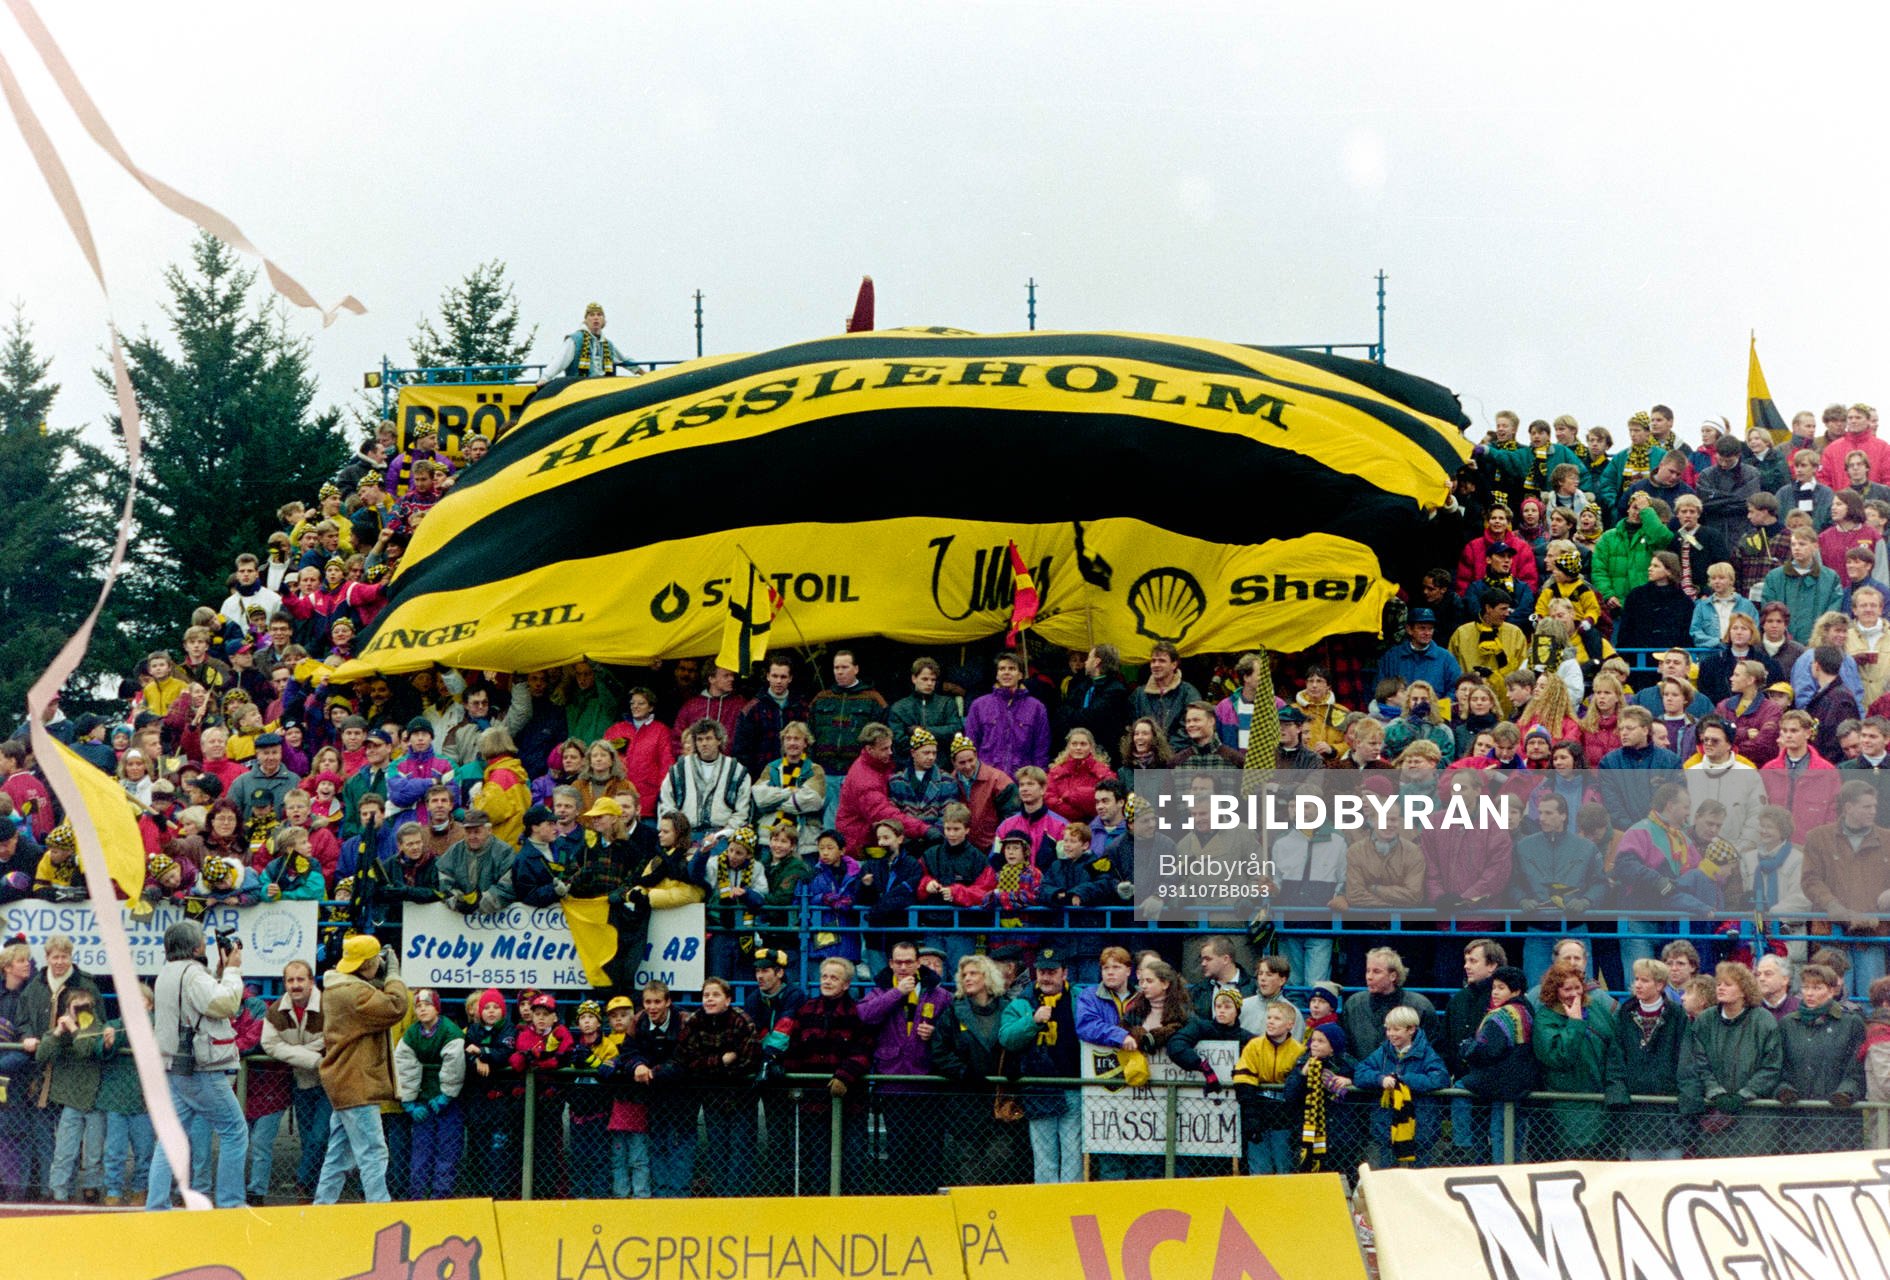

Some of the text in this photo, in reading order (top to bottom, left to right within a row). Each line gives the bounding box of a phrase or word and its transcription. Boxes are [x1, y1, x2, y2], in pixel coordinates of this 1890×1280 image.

[526, 360, 1296, 477] HÄSSLEHOLM
[702, 572, 860, 607] STOIL
[1229, 574, 1376, 606] Shel
[368, 603, 585, 651] INGE BIL
[407, 934, 482, 967] Stoby
[662, 936, 701, 962] AB
[1090, 1108, 1237, 1144] HÄSSLHOLM
[556, 1223, 933, 1280] LÅGPRISHANDLA
[962, 1210, 1009, 1265] PÅ
